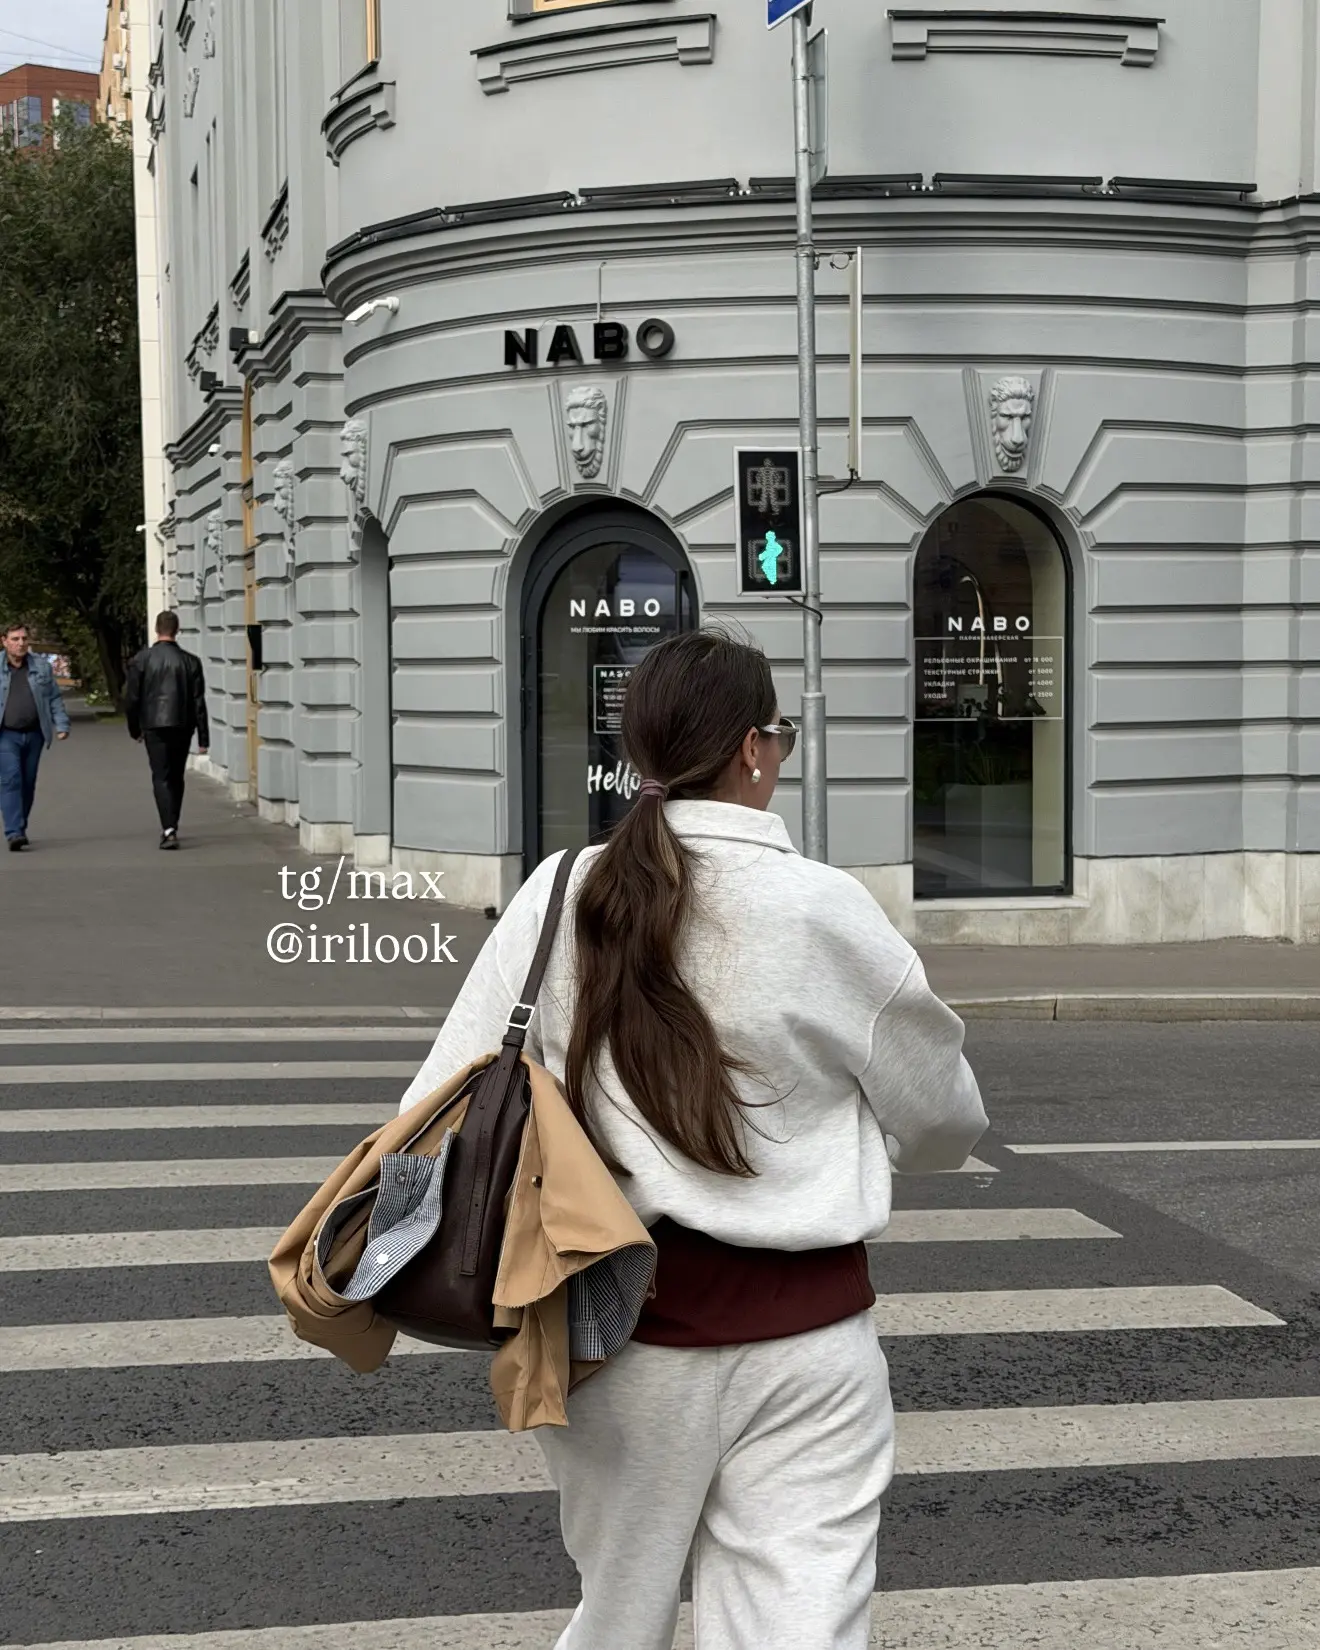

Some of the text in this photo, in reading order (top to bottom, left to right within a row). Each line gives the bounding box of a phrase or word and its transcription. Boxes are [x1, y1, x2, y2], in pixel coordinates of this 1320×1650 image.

[504, 317, 676, 368] NABO
[569, 598, 661, 617] NABO
[947, 615, 1031, 632] NABO
[587, 760, 642, 800] Hello
